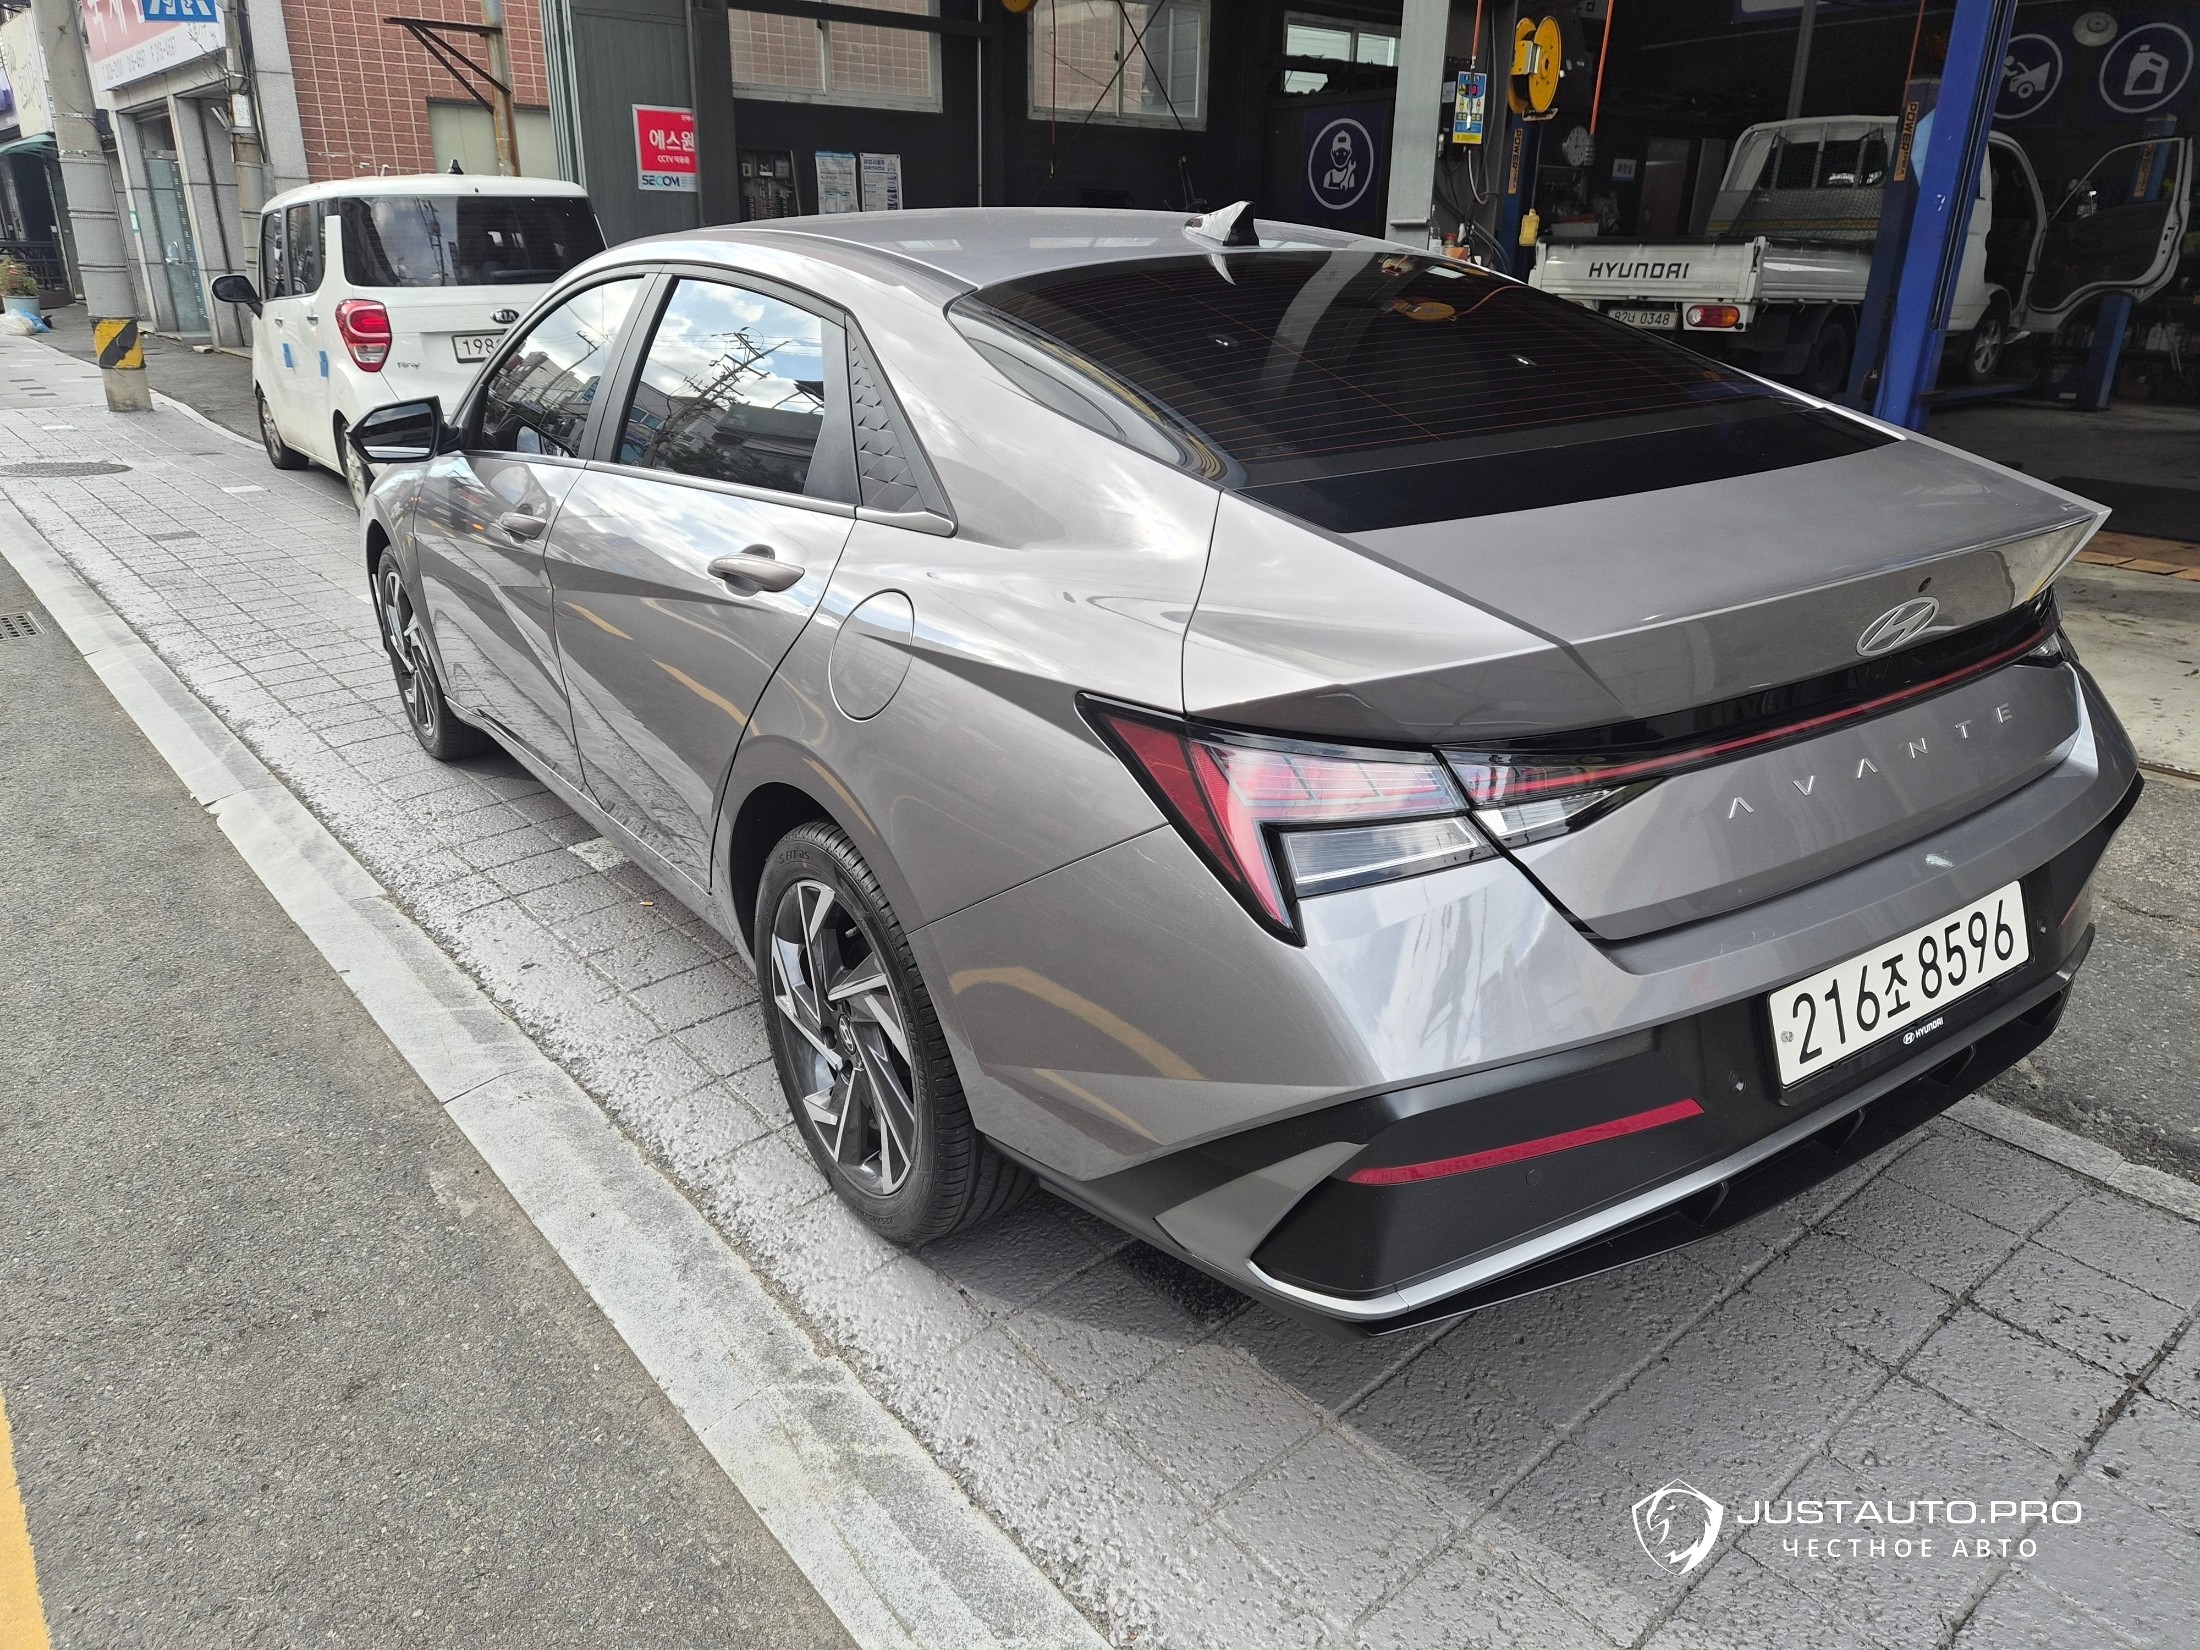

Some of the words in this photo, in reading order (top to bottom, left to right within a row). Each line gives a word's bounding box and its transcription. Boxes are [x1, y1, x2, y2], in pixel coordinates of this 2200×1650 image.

[648, 129, 696, 152] 에스원
[641, 175, 680, 187] SECOM
[1588, 262, 1691, 279] HYUNDAI
[493, 311, 517, 321] KIA
[1639, 312, 1671, 326] 0348
[462, 338, 501, 355] 198
[1728, 702, 2013, 819] AVANTE
[1915, 1017, 1944, 1039] HYUNDAI
